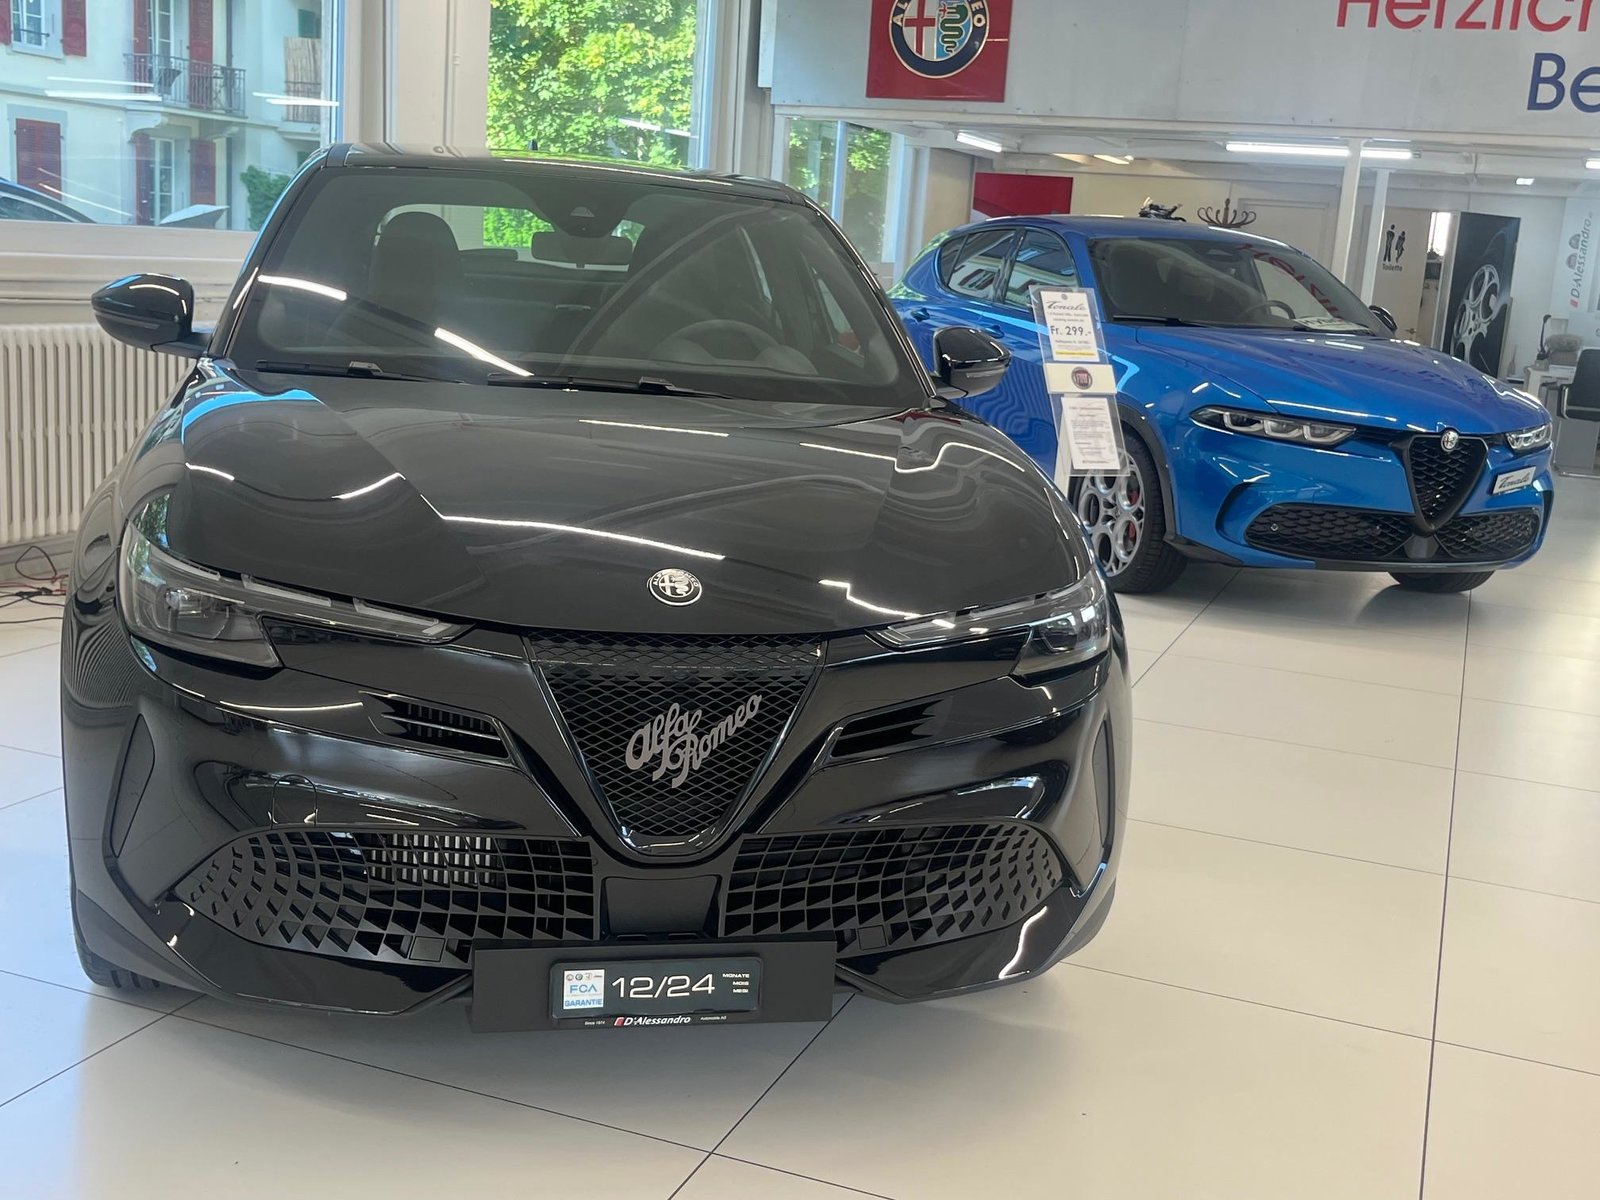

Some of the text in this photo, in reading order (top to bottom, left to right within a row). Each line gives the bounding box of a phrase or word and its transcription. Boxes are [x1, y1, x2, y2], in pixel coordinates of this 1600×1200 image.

[1046, 300, 1087, 310] Tonale
[1050, 325, 1063, 335] Fr.
[625, 694, 763, 789] Alfa Romeo
[569, 984, 598, 993] FCA
[611, 973, 715, 999] 12/24
[564, 998, 603, 1008] GARANTIE
[623, 1015, 691, 1026] D'Alessandro
